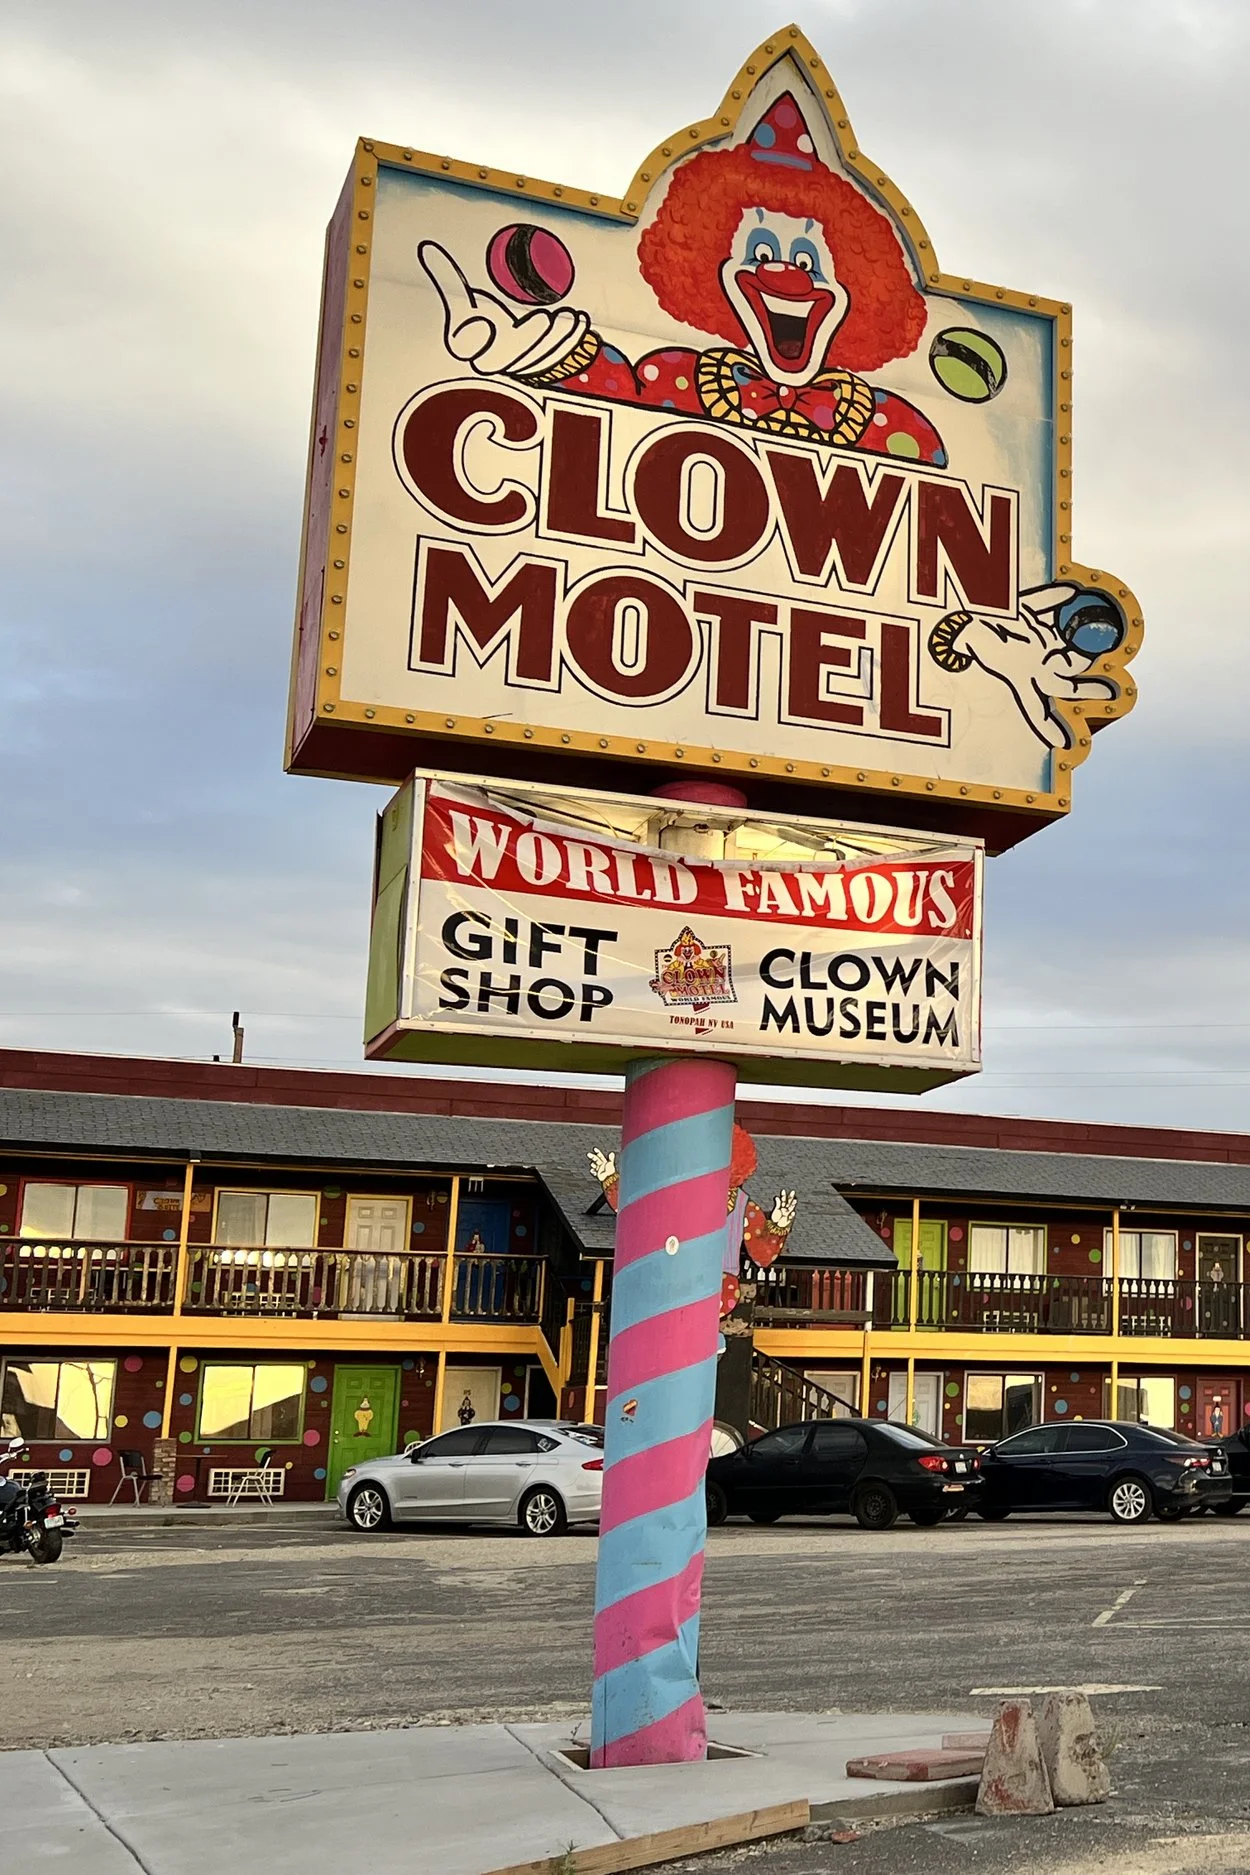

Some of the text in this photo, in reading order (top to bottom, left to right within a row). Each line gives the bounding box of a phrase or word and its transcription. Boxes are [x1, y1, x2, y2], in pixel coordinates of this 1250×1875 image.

[398, 382, 1016, 614] CLOWN
[412, 538, 947, 743] MOTEL
[448, 809, 958, 929] WORLD FAMOUS
[441, 910, 619, 977] GIFT
[438, 967, 614, 1022] SHOP
[662, 966, 727, 985] CLOWN
[674, 984, 730, 996] MOTEL
[759, 948, 960, 1001] CLOWN
[669, 1015, 735, 1030] TONOPAH NV USA
[759, 993, 960, 1047] MUSEUM
